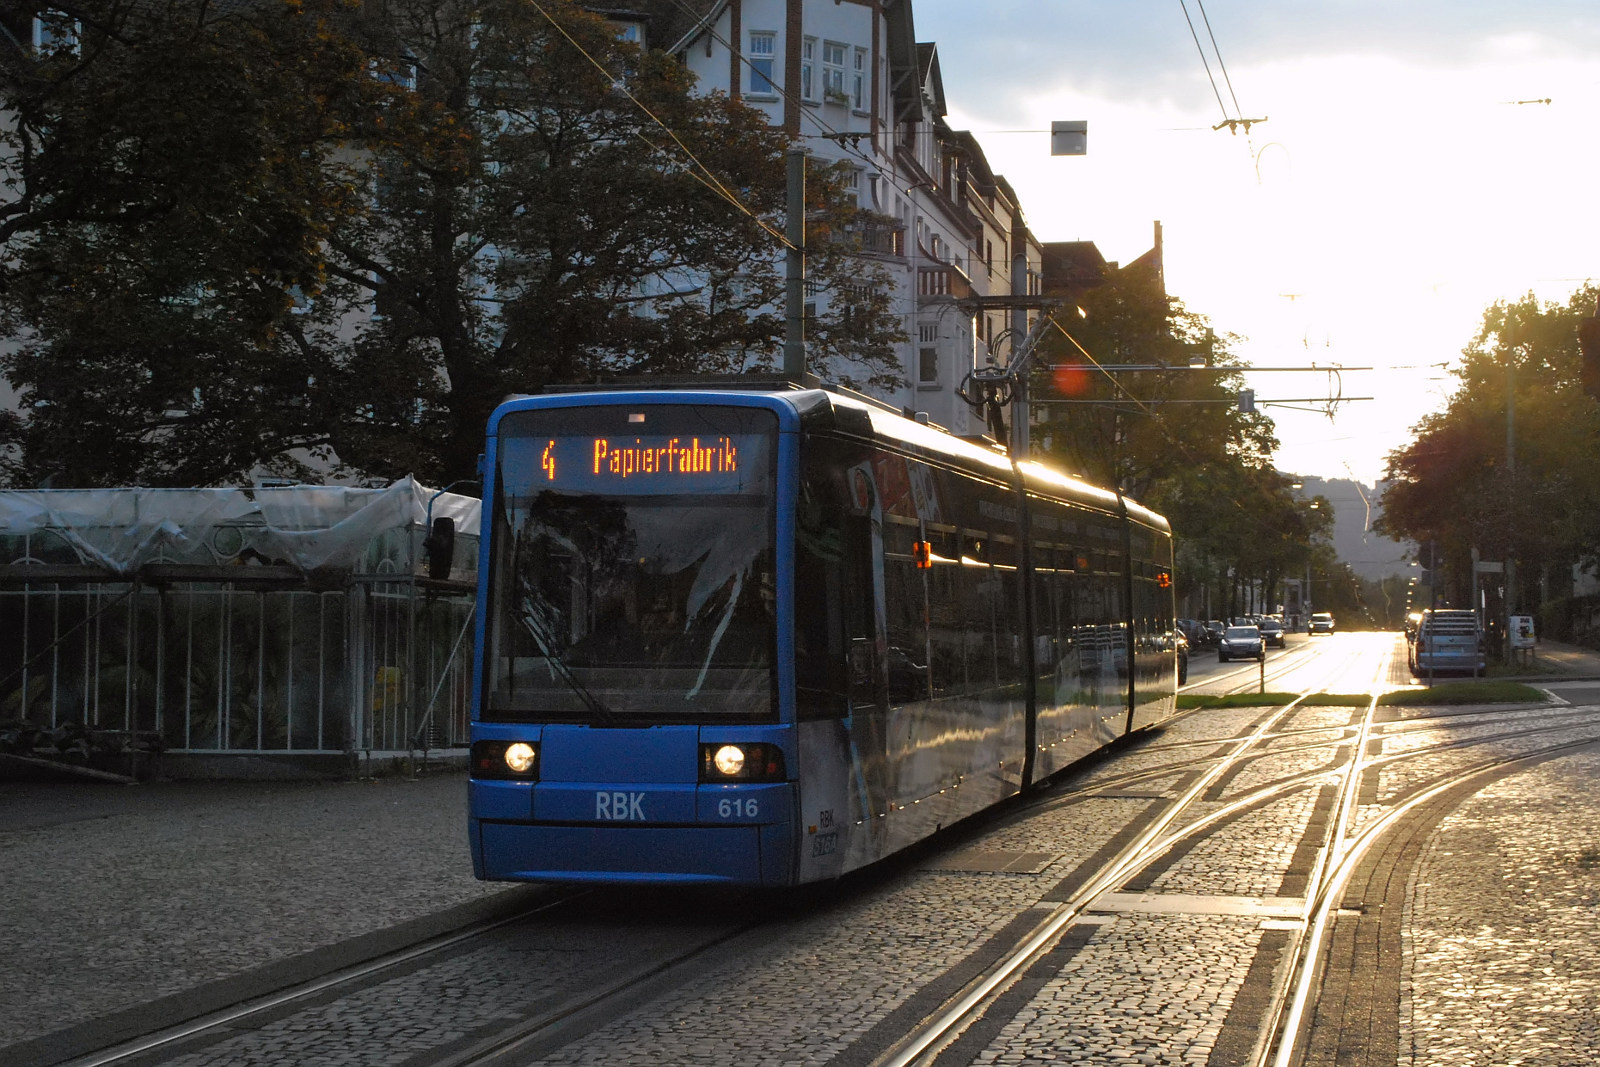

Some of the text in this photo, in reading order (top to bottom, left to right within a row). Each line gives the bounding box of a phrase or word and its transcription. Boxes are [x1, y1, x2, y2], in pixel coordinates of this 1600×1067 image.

[542, 437, 736, 480] 4 Papierfabrik
[596, 791, 646, 820] RBK
[718, 798, 758, 818] 616
[820, 809, 834, 829] RBK
